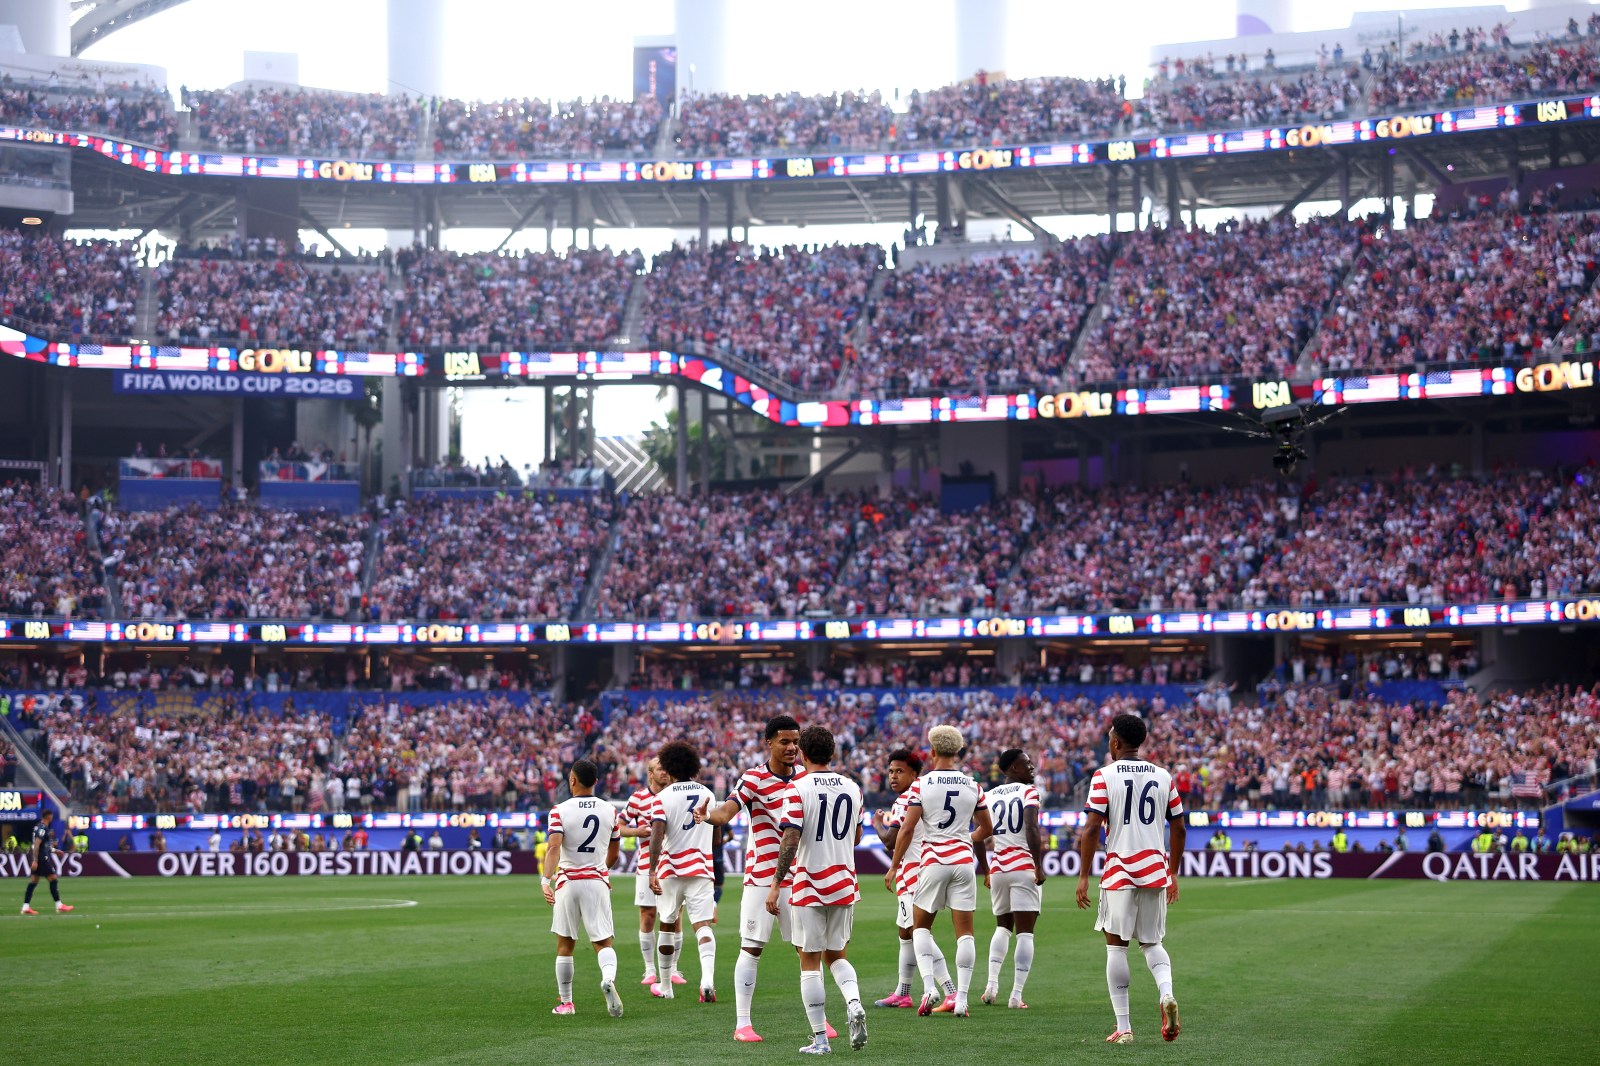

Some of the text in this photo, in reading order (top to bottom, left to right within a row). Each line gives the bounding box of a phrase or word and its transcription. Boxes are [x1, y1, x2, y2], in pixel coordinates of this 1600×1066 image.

[319, 160, 373, 181] GOAL!
[469, 164, 496, 182] USA
[641, 161, 693, 181] GOAL!
[787, 158, 814, 177] USA
[959, 149, 1012, 170] GOAL!
[1108, 141, 1136, 161] USA
[1376, 116, 1433, 138] GOAL!
[1537, 101, 1567, 122] USA
[238, 349, 480, 376] GOAL! USA
[123, 374, 353, 395] FIFA WORLD CUP 2026
[1038, 362, 1594, 418] GOAL! USA GOAL!
[25, 622, 50, 640] USA
[125, 622, 174, 641] GOAL!
[261, 625, 287, 642] USA
[416, 624, 463, 642] GOAL!
[697, 622, 743, 640] GOL!
[814, 777, 843, 786] PULISIC
[938, 776, 971, 786] ROBINSON
[1117, 765, 1156, 774] FREEMAN
[578, 801, 596, 809] DEST
[682, 795, 700, 830] 3
[938, 790, 960, 829] 5
[992, 797, 1024, 835] 20
[1123, 780, 1159, 825] 16
[816, 793, 853, 841] 10
[577, 814, 600, 853] 2
[0, 852, 83, 877] RWYS
[158, 851, 512, 877] OVER 160 DESTINATIONS
[1422, 852, 1540, 882] QATAR
[900, 901, 907, 917] 8
